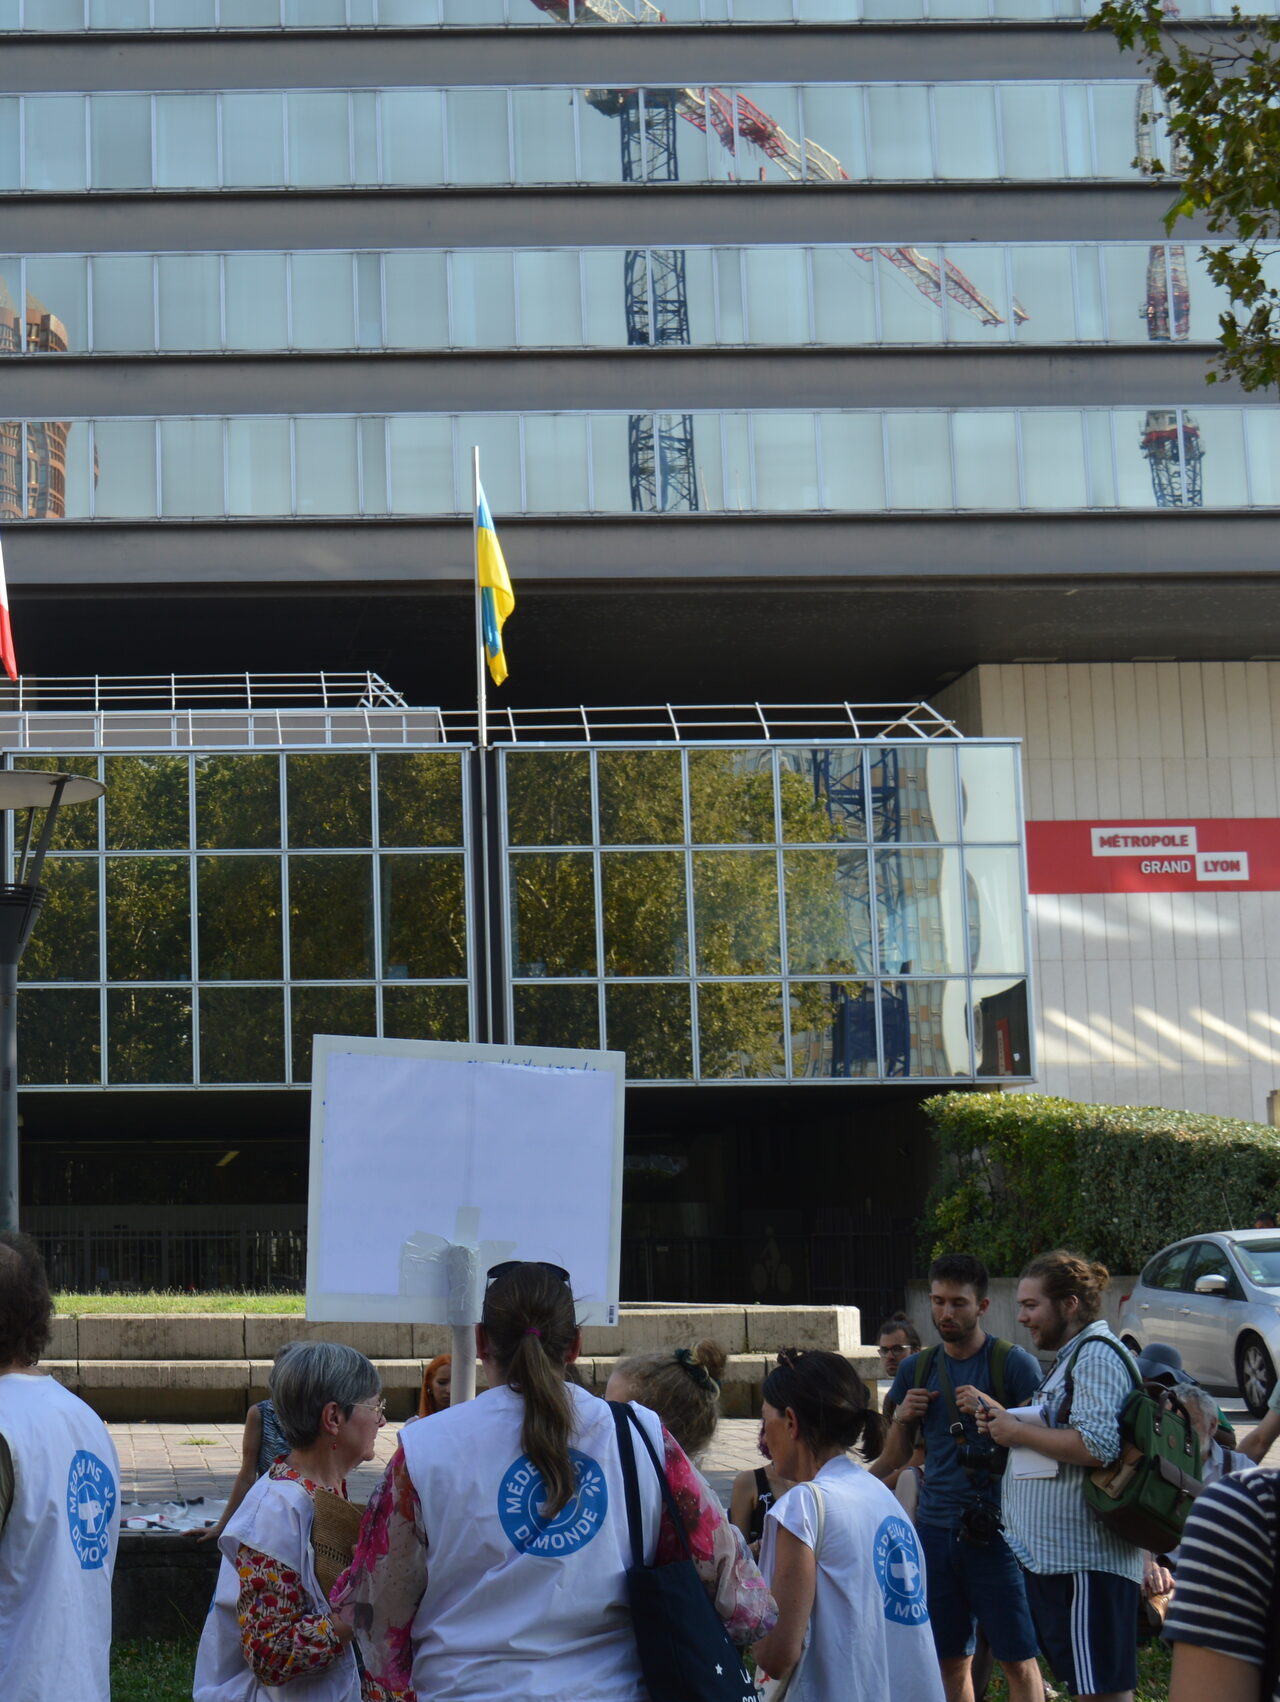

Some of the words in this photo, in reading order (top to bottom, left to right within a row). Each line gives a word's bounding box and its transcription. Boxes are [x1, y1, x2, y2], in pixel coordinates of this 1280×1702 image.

[1099, 834, 1189, 848] MÉTROPOLE
[1141, 860, 1192, 874] GRAND
[1204, 860, 1241, 873] LYON
[505, 1460, 585, 1514] MÉDES
[532, 1508, 598, 1550] MONDE
